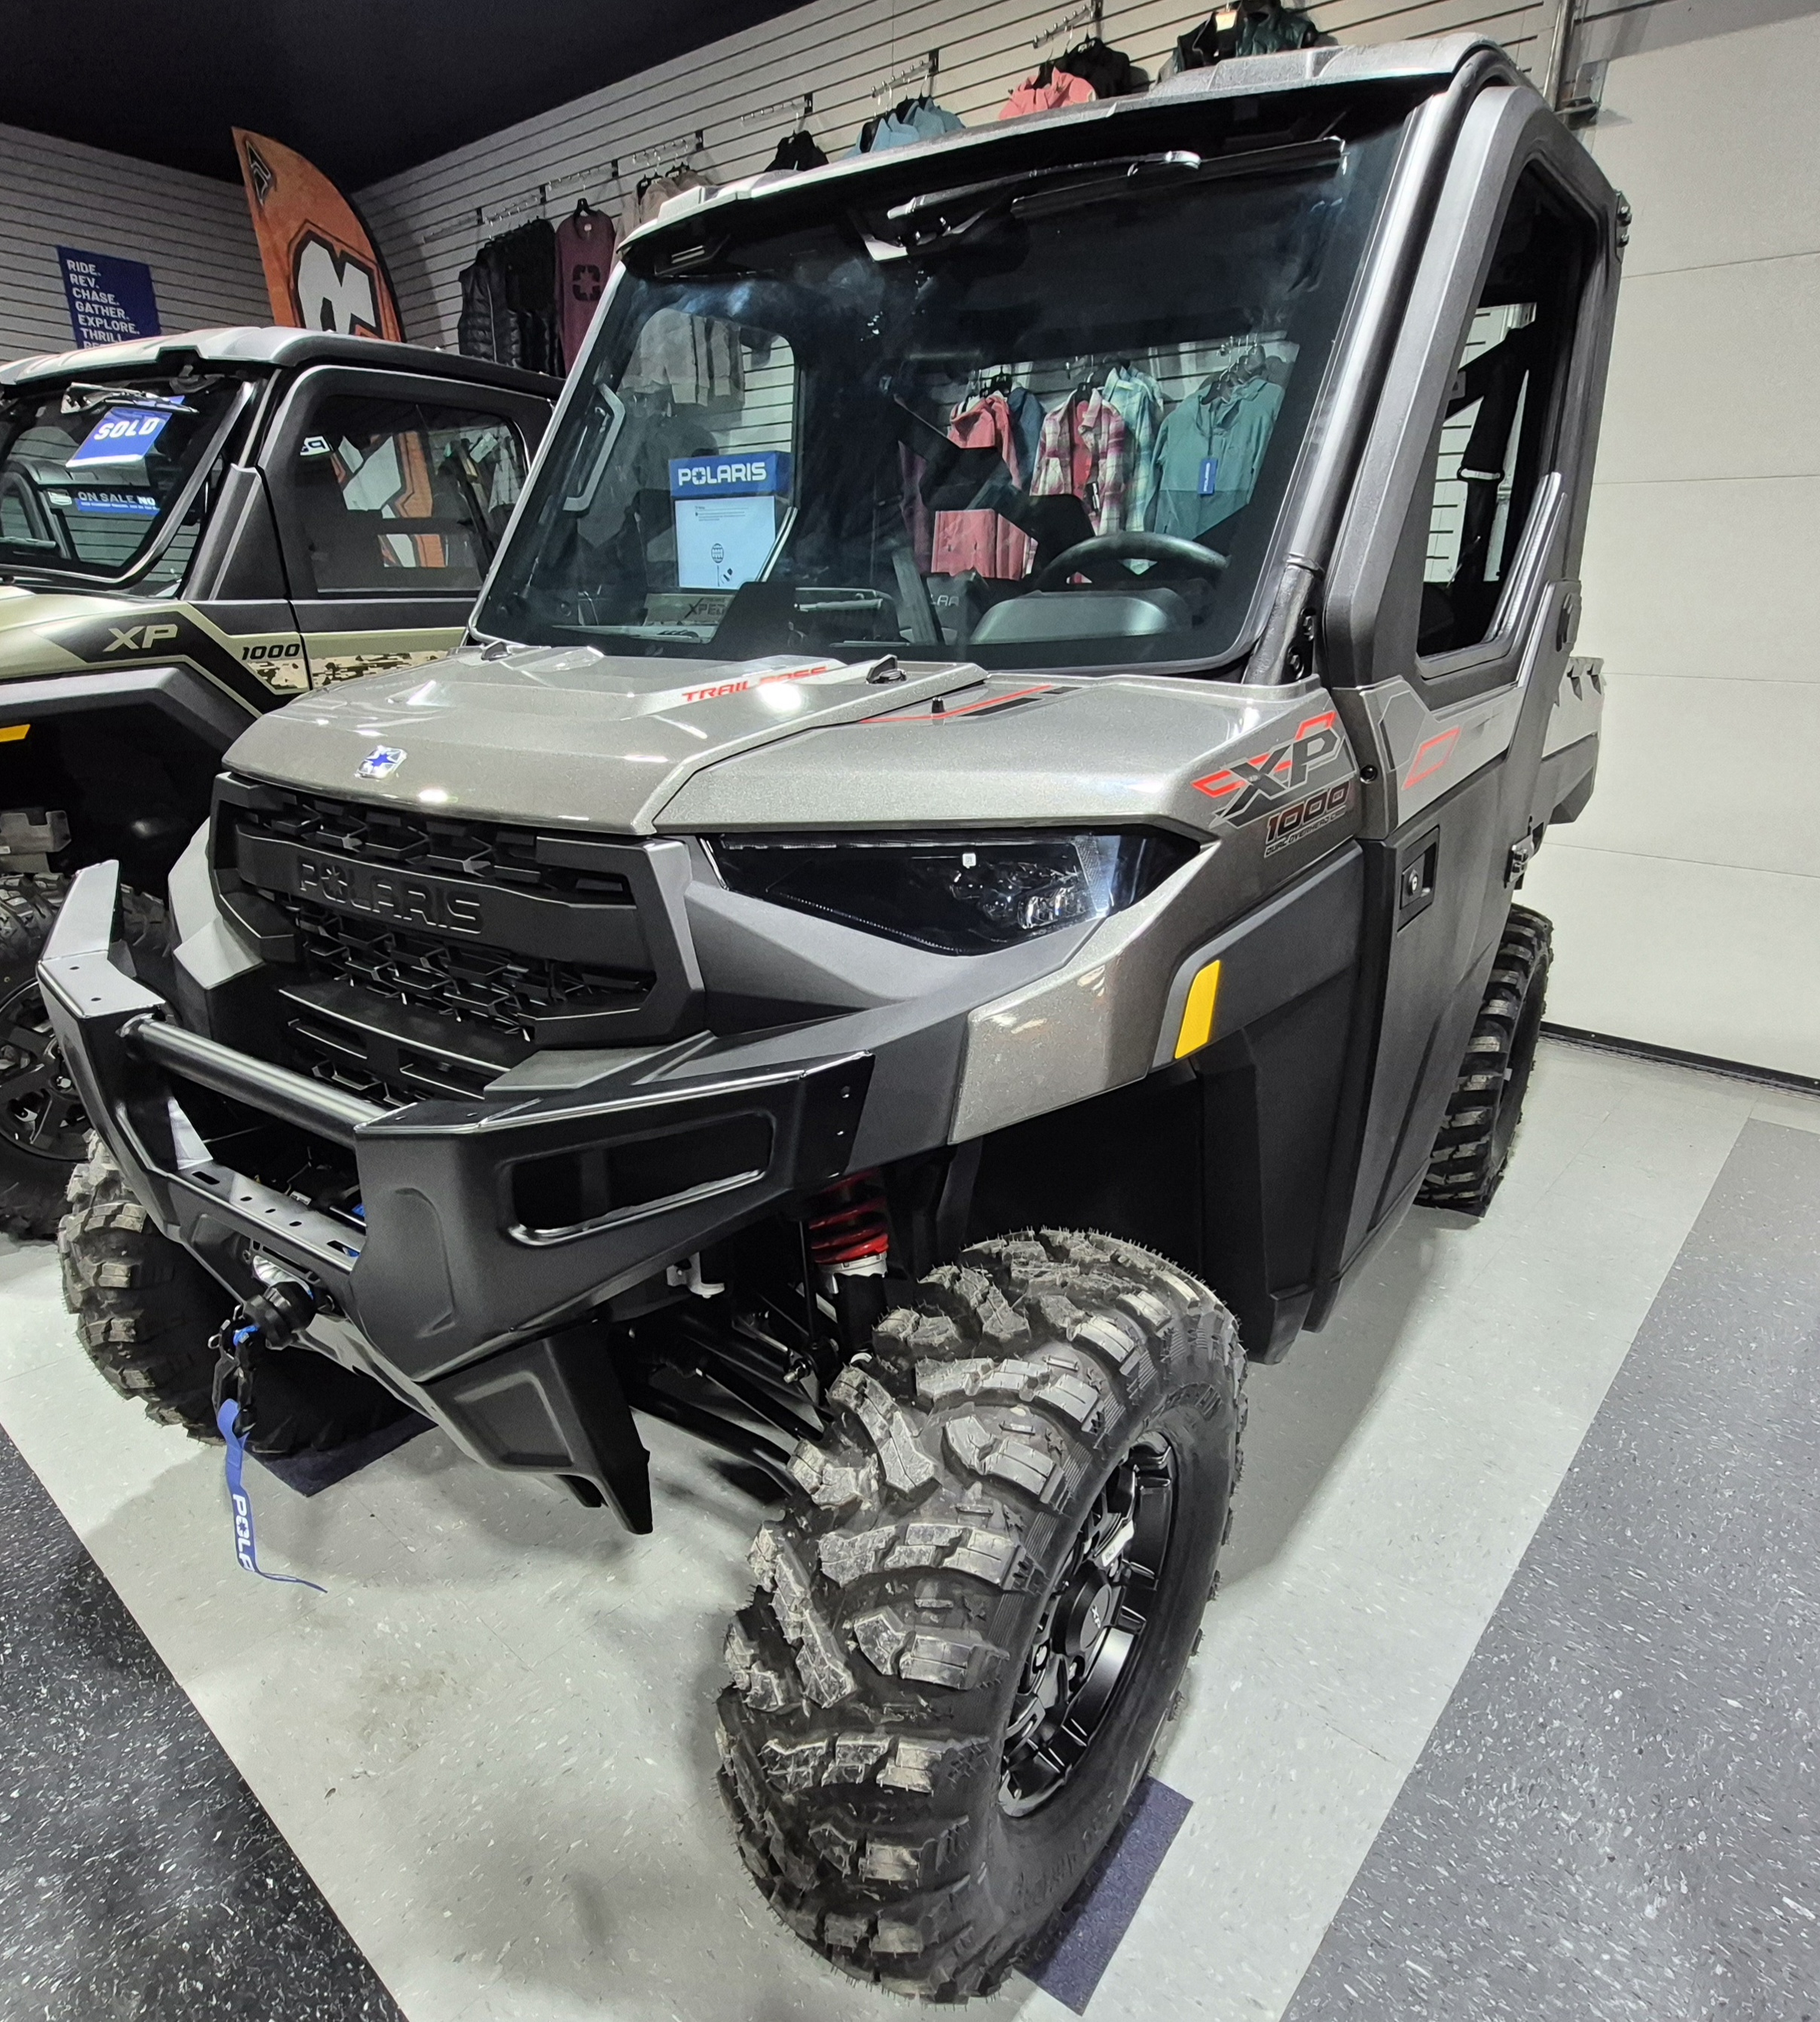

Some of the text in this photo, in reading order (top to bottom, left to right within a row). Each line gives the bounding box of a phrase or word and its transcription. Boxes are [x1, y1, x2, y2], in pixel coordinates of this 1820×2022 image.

[66, 259, 102, 277] RIDE.
[69, 273, 100, 289] REV.
[72, 287, 121, 306] CHASE.
[75, 301, 130, 321] GATHER.
[78, 314, 140, 334] EXPLORE.
[93, 417, 160, 441] SOLD
[678, 462, 767, 486] POLARIS
[78, 491, 99, 502] ON
[99, 492, 136, 504] SALE
[102, 624, 179, 652] XP
[242, 643, 301, 661] 1000
[1209, 727, 1341, 828] XP
[1266, 780, 1350, 845] 1000
[299, 862, 482, 935] POLARIS
